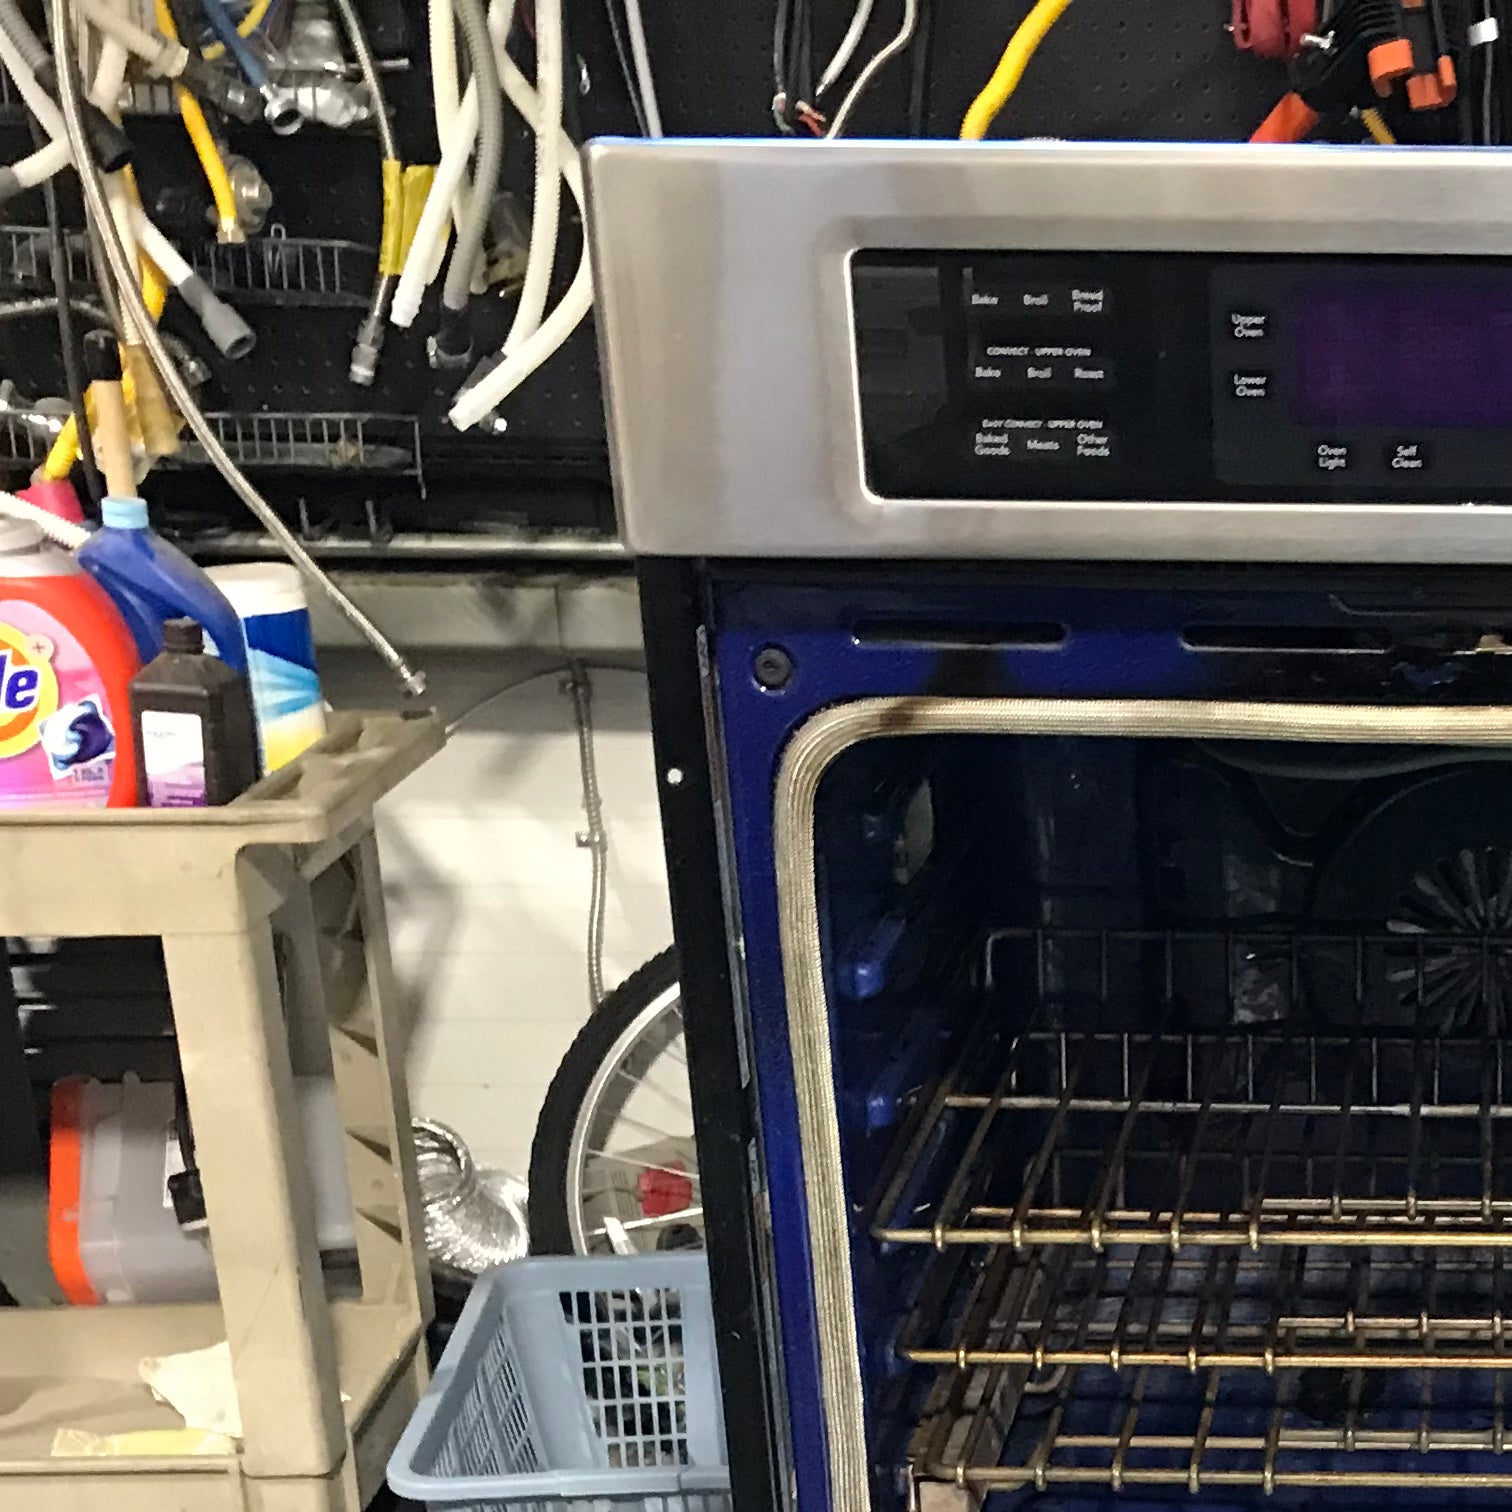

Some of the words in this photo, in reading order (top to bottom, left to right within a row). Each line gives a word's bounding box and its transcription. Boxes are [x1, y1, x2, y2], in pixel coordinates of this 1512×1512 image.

[1231, 313, 1266, 327] Upper
[1234, 326, 1264, 337] Oven
[1234, 374, 1267, 385] Lower
[1236, 385, 1266, 397] Oven
[1317, 444, 1347, 456] Oven
[1397, 445, 1418, 457] Self
[1392, 457, 1423, 469] Clean
